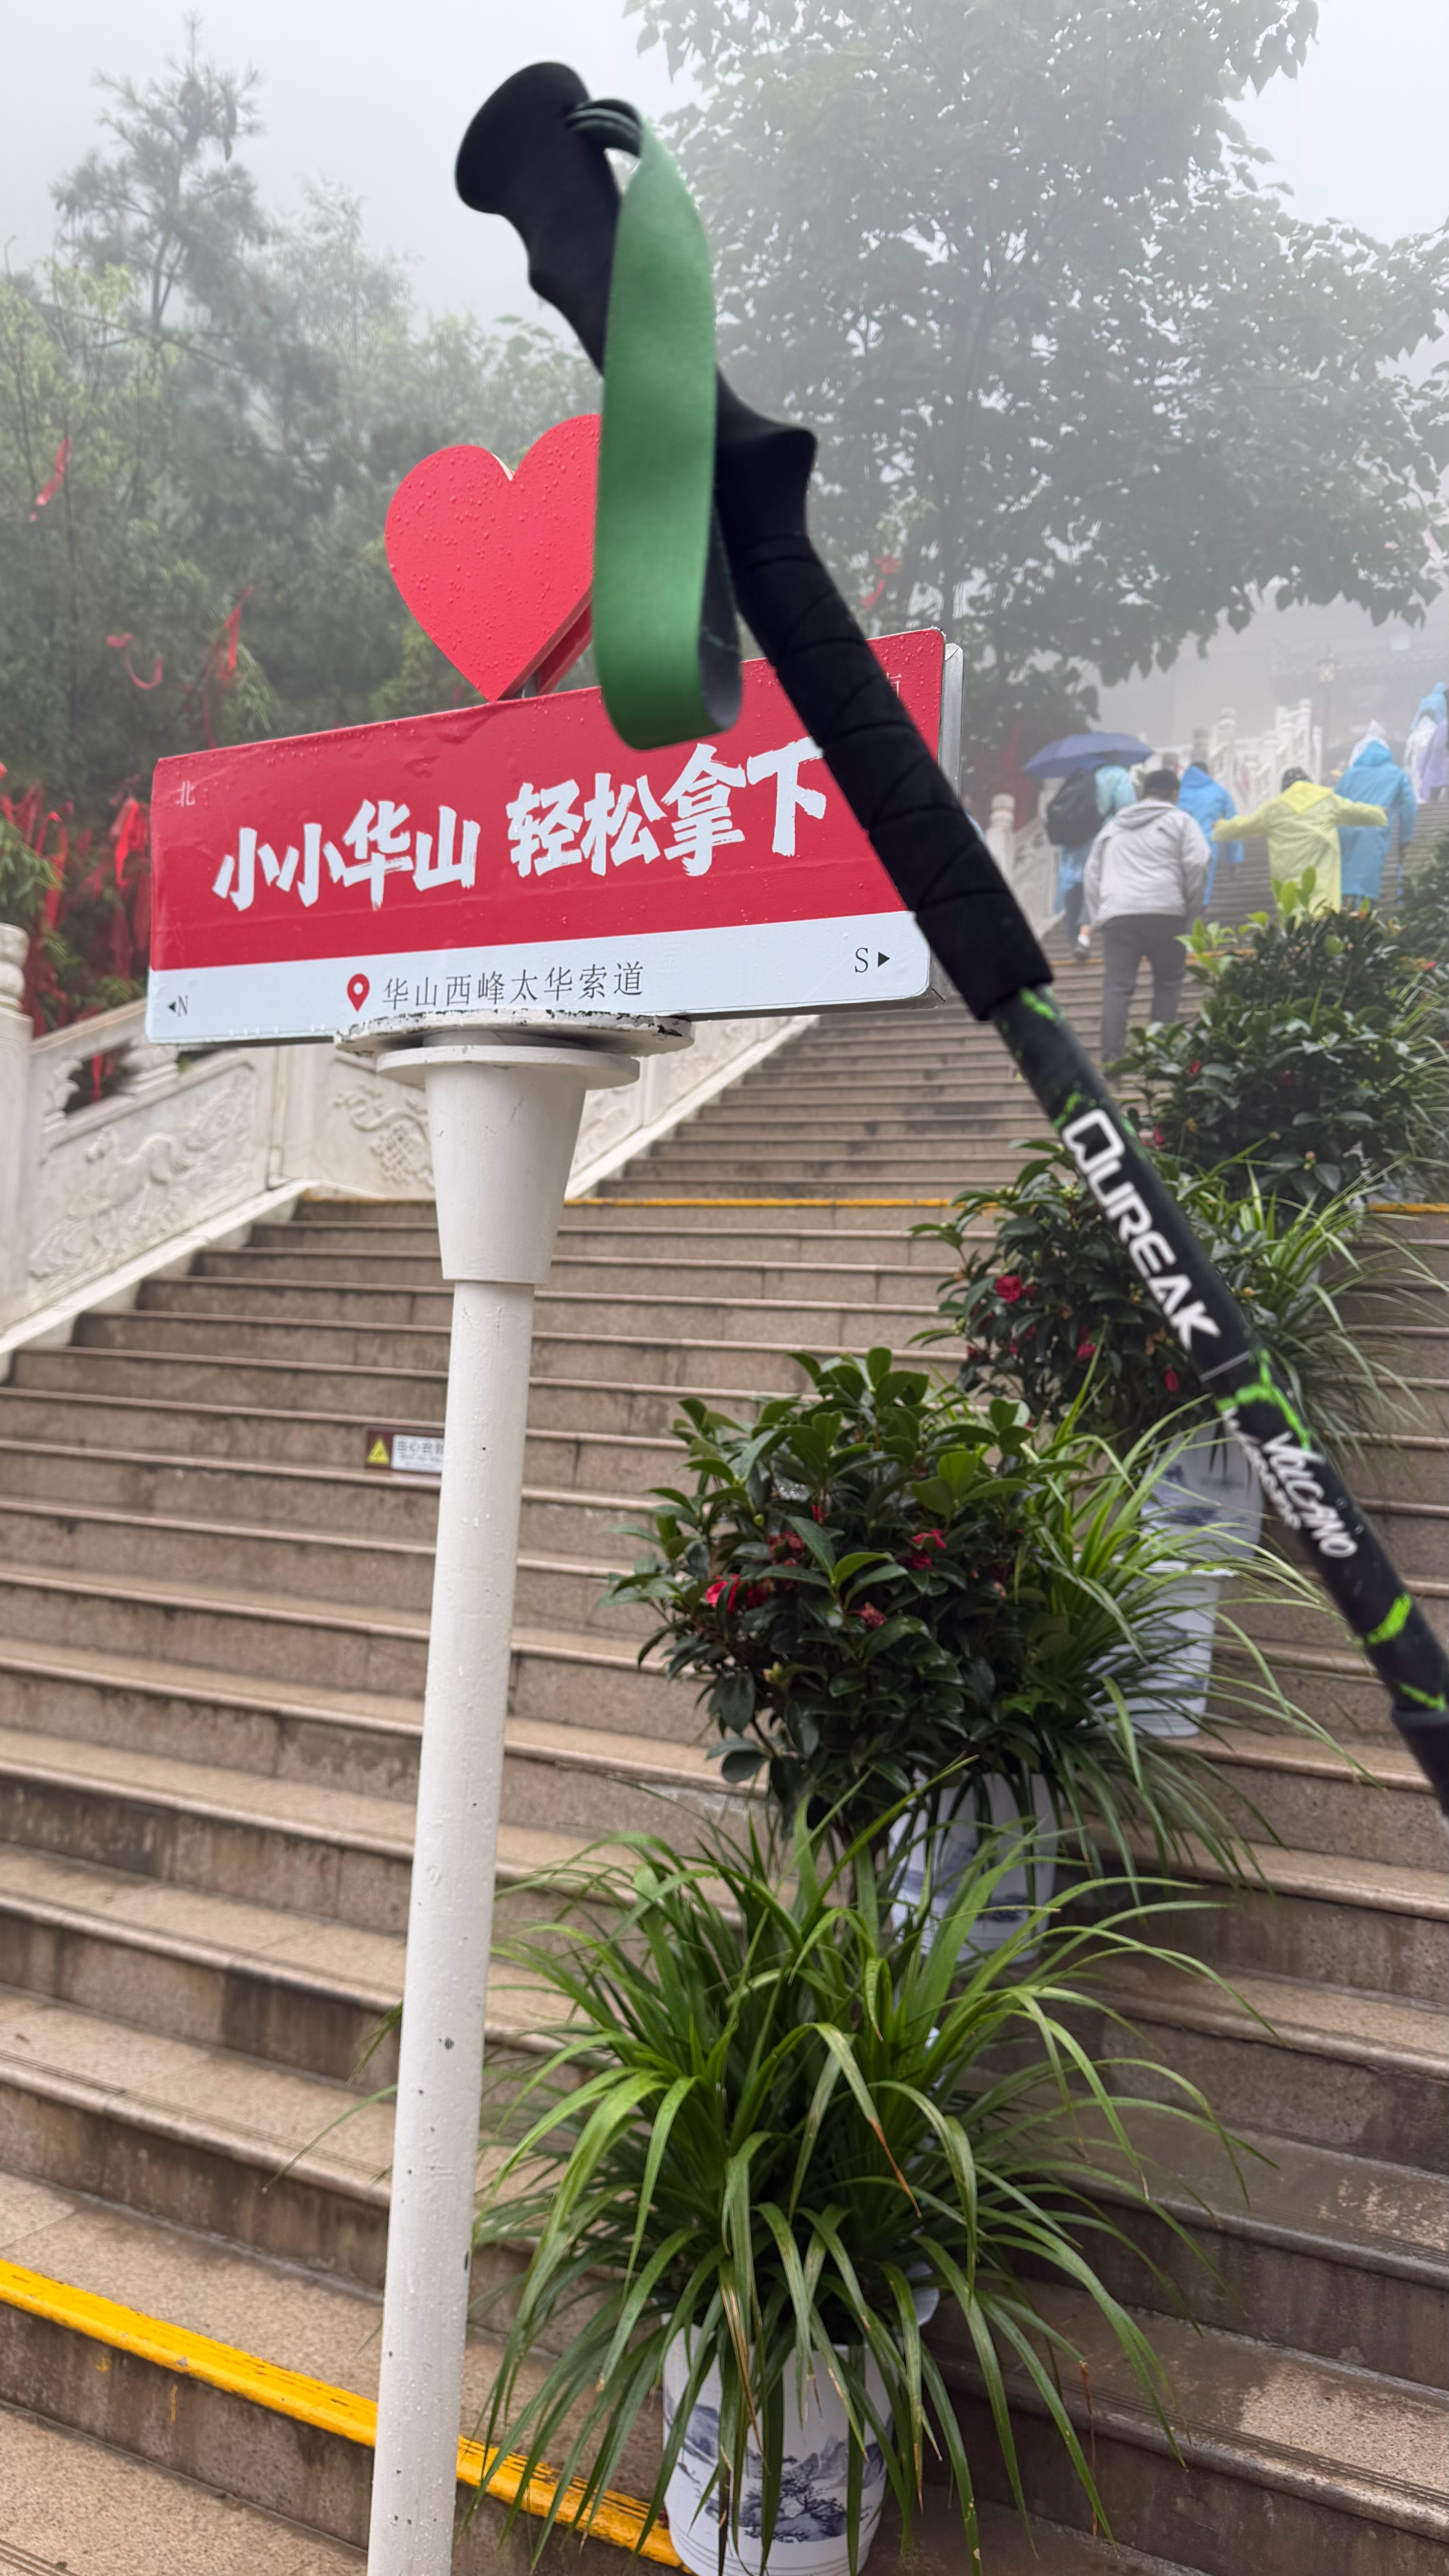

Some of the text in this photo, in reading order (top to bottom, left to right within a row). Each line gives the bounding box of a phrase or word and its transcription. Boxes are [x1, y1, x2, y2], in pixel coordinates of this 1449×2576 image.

[175, 779, 196, 807] 北
[212, 736, 826, 911] 小小华山 轻松拿下
[855, 947, 868, 973] S
[383, 961, 644, 1010] 华山西峰太华索道
[177, 994, 189, 1017] N
[1262, 1430, 1358, 1558] VOLCANO
